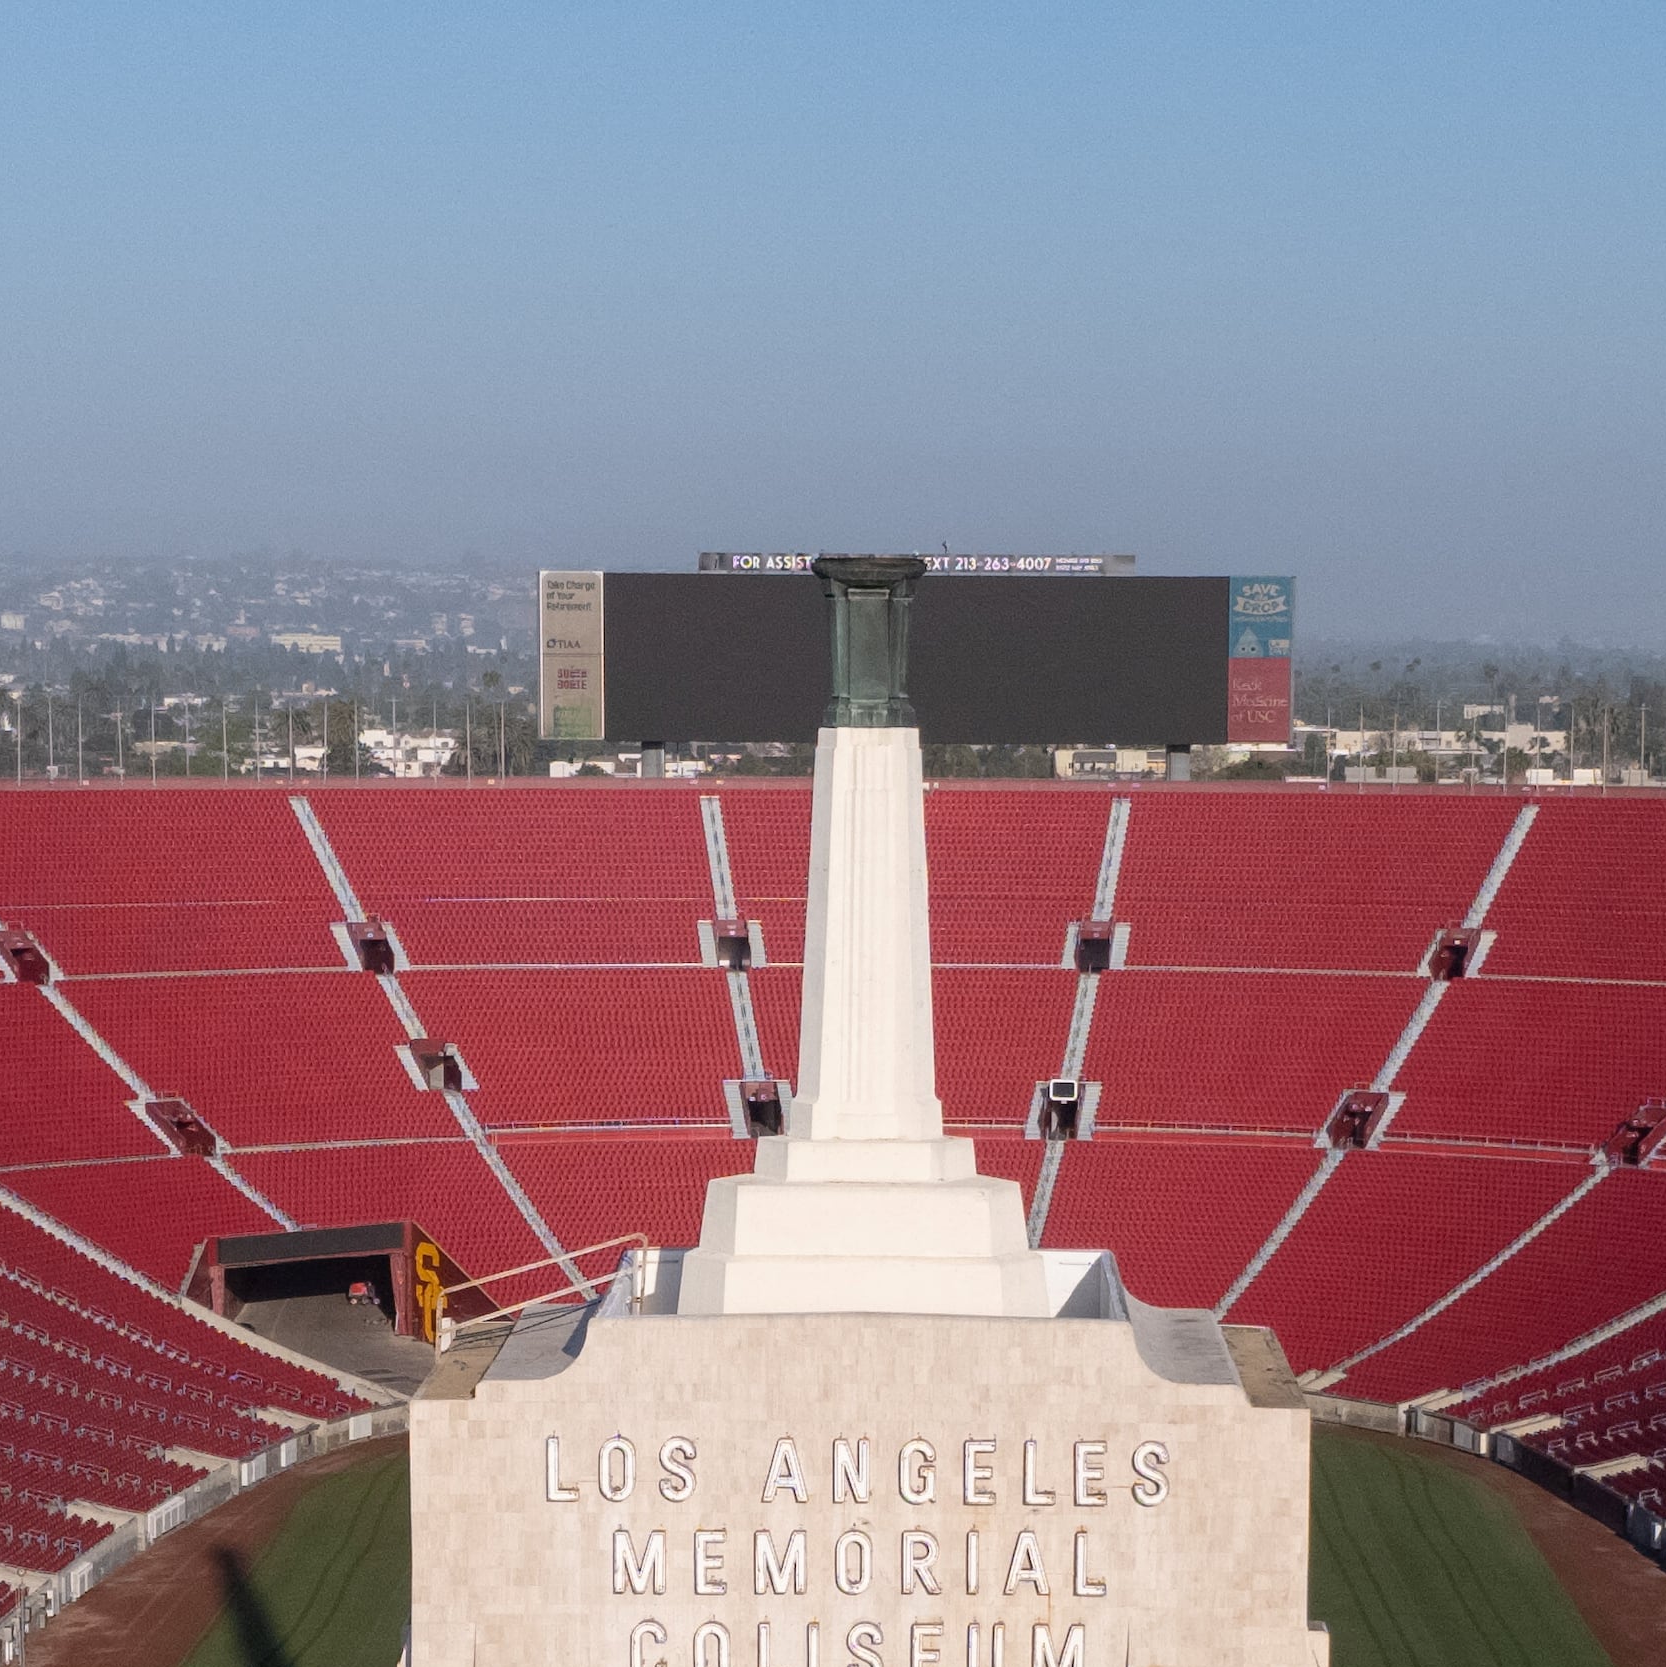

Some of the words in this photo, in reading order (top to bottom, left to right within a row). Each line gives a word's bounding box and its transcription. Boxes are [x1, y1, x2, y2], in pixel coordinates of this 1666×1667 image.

[732, 555, 760, 569] FOR
[955, 556, 1052, 571] 213-263-4007
[547, 580, 564, 590] Take
[566, 580, 595, 592] Charge
[1242, 583, 1281, 596] SAVE
[557, 592, 575, 600] Your
[546, 602, 592, 611] Retirement
[558, 640, 581, 649] TIAA
[1232, 694, 1289, 707] Medicine
[1247, 710, 1277, 724] USC
[544, 1435, 697, 1504] LOS
[760, 1436, 1171, 1507] ANGELES
[612, 1528, 1107, 1597] MEMORIAL
